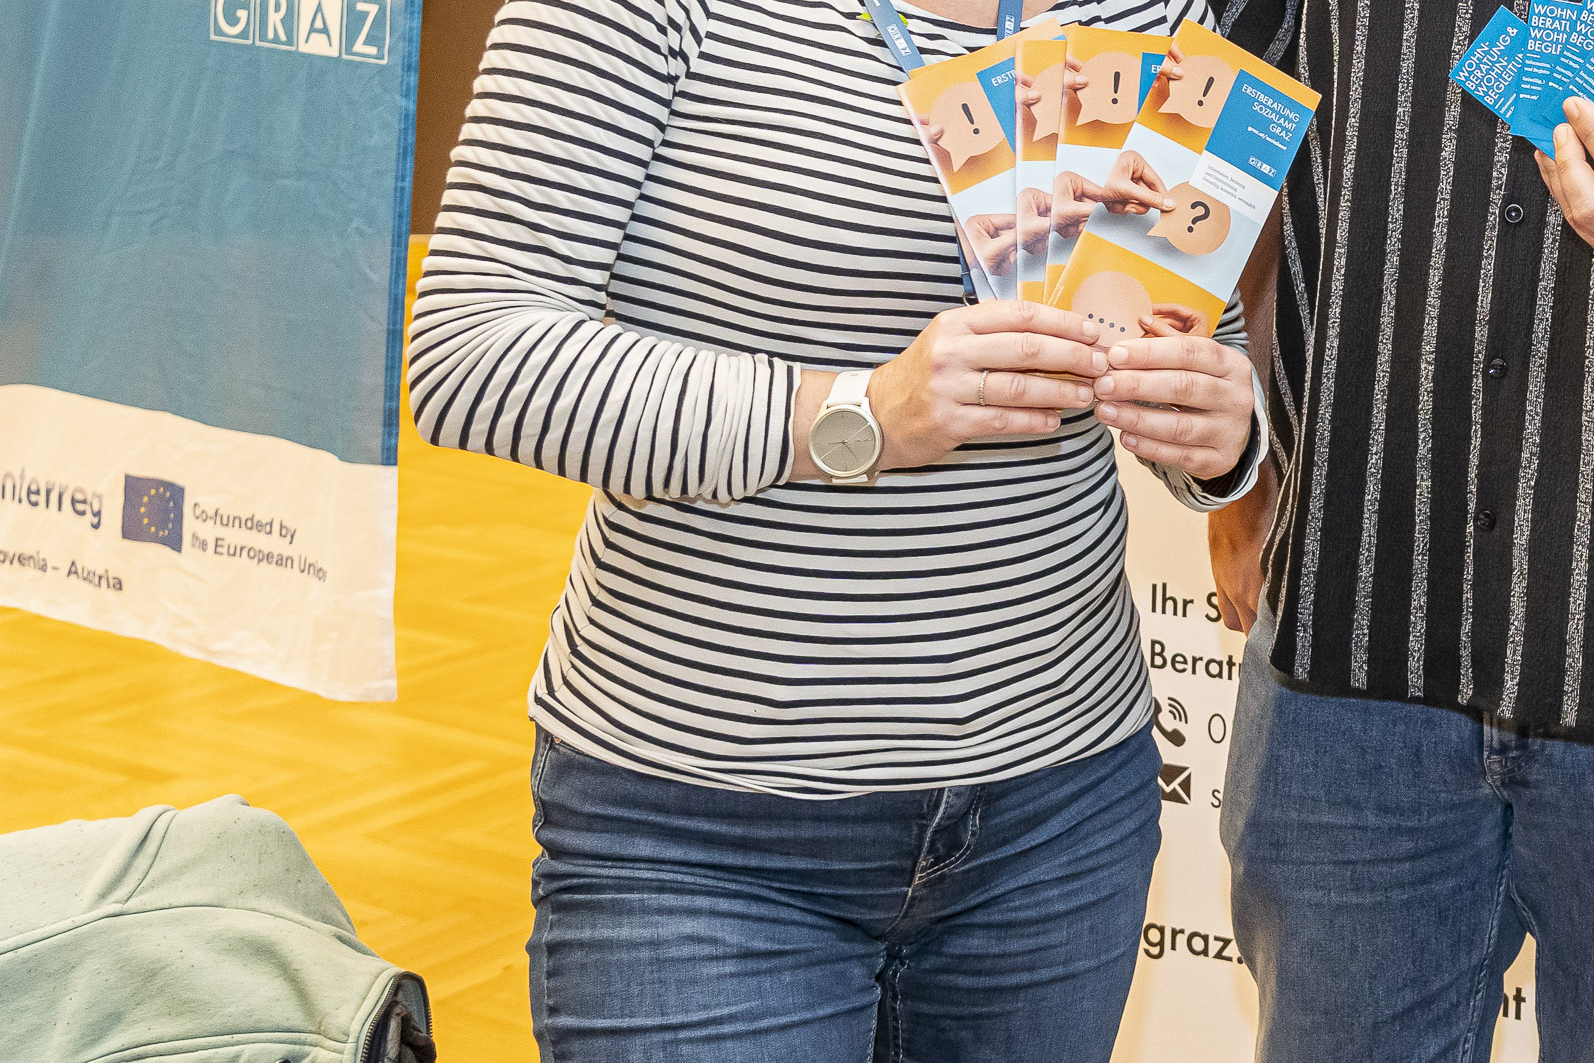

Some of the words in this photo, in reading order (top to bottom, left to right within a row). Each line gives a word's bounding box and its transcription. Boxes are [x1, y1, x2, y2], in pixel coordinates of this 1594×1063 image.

[1533, 3, 1578, 21] WOHN
[1455, 41, 1490, 82] WOHN-
[1465, 34, 1511, 91] BERATUNG
[1506, 26, 1519, 37] &
[1474, 56, 1508, 97] WOHN-
[1241, 83, 1300, 123] ERSTBERATUNG
[1251, 101, 1297, 132] SOZIALAMT
[1269, 123, 1293, 142] GRAZ
[192, 502, 274, 536] Co-funded
[279, 519, 297, 545] by
[213, 537, 294, 570] European
[1151, 582, 1195, 618] Ihr
[1150, 638, 1242, 681] Berat
[1143, 922, 1244, 965] graz.
